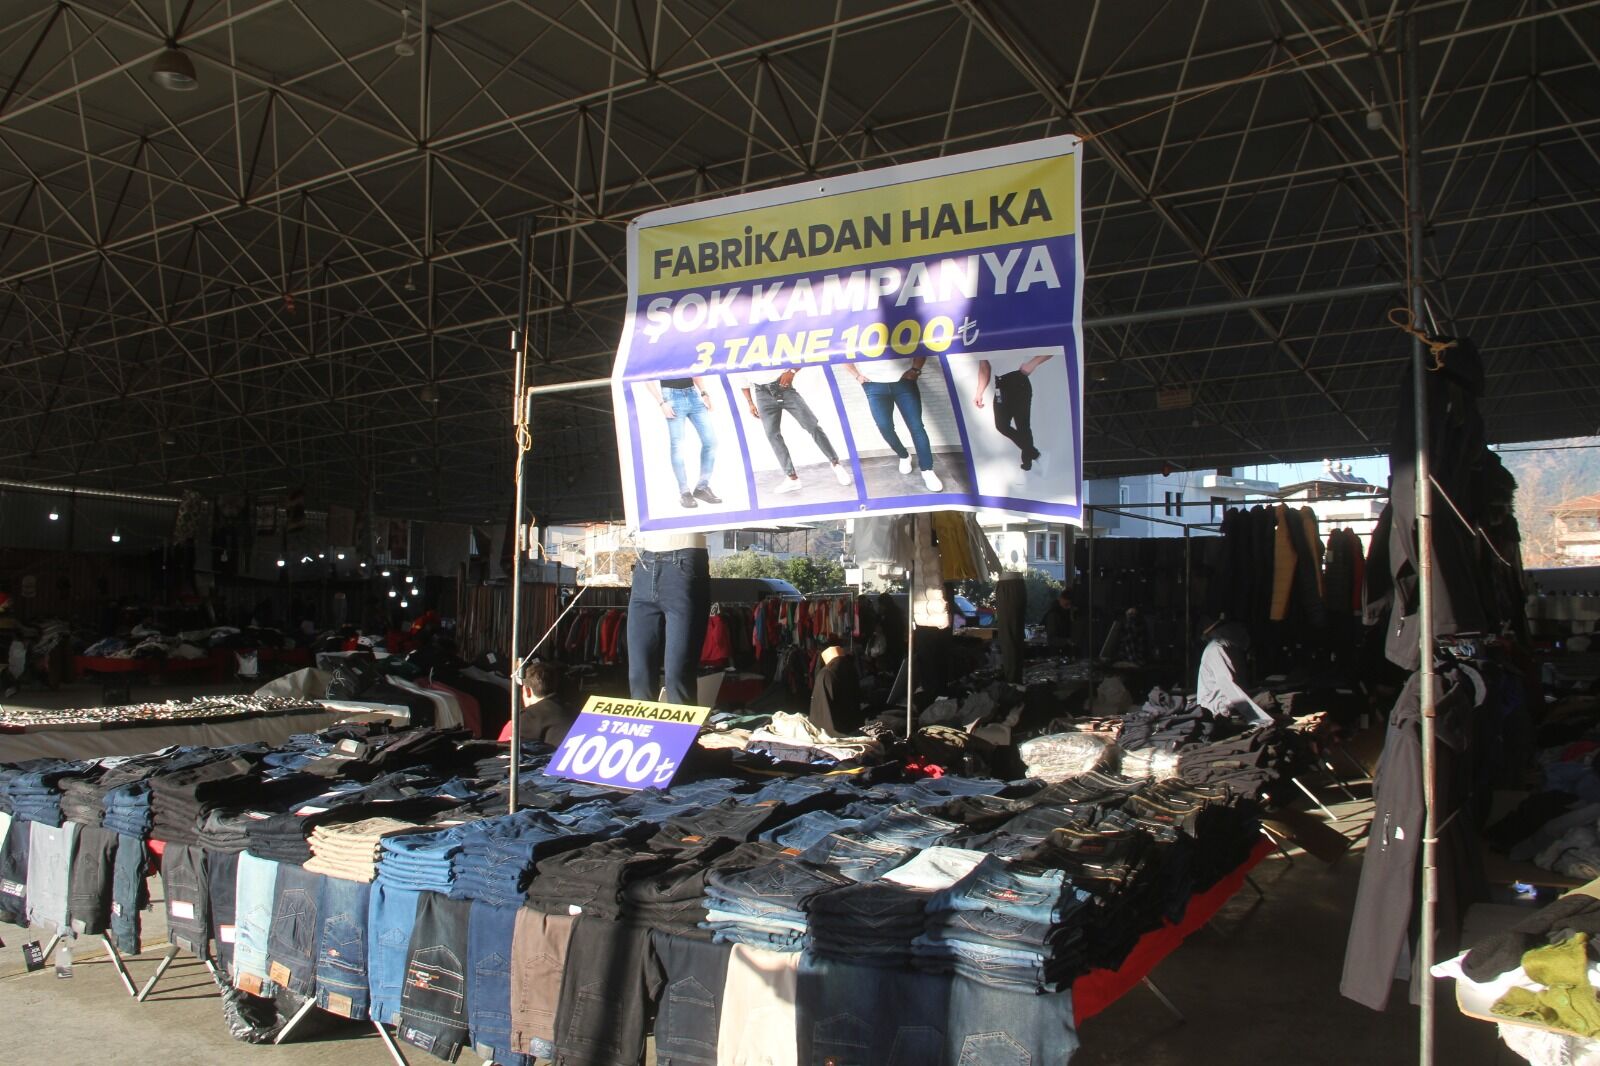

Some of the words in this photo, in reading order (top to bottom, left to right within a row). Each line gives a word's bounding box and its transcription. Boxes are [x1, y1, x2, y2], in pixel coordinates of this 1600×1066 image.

[653, 212, 892, 280] FABRİKADAN
[902, 188, 1053, 243] HALKA
[643, 288, 744, 344] ŞOK
[748, 245, 1061, 324] KAMPANYA
[691, 342, 718, 372] 3
[723, 335, 833, 370] TANE
[592, 702, 696, 723] FABRİKADAN
[597, 720, 610, 733] 3
[611, 721, 654, 737] TANE
